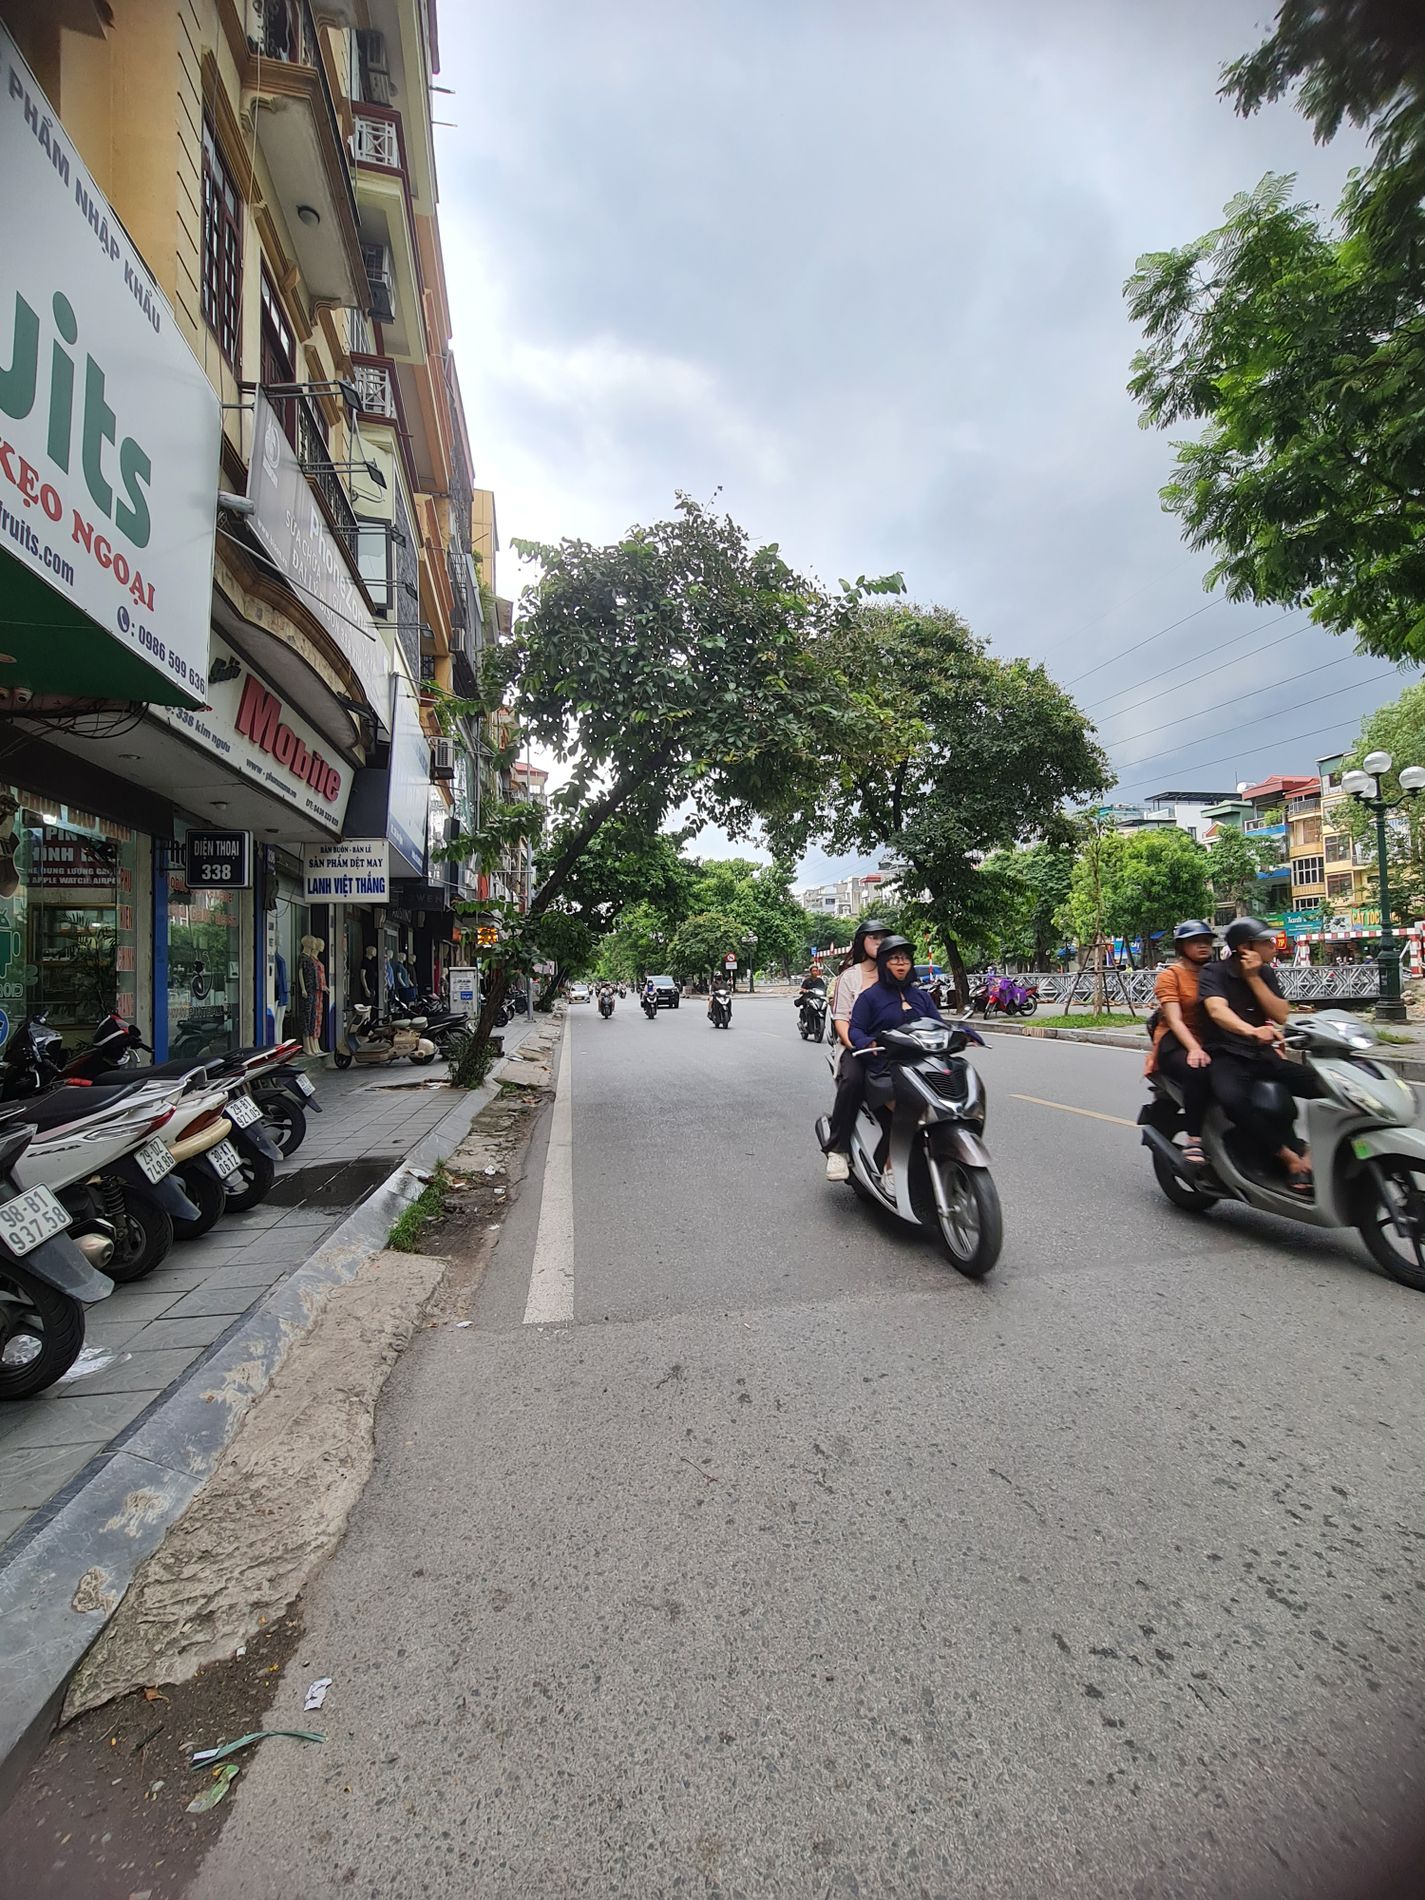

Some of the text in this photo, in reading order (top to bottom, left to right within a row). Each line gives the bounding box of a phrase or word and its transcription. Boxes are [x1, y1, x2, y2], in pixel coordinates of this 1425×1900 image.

[9, 64, 160, 334] PHẨM NHẬP KHẨU
[72, 509, 156, 612] NGOẠI
[138, 625, 166, 662] 0986
[168, 650, 187, 679] 599
[189, 669, 206, 695] 636
[176, 705, 194, 726] 338
[195, 719, 212, 741] kim
[234, 673, 342, 804] Mobile
[215, 839, 240, 860] THOẠI
[308, 854, 384, 869] SẢN PHẨM DỆT MAY
[201, 863, 231, 880] 338
[307, 871, 385, 897] LANH VIỆT THẮNG
[230, 1098, 252, 1117] 29-B1
[236, 1108, 261, 1129] 921.05
[138, 1142, 161, 1166] 29-D2
[219, 1152, 239, 1174] 0612
[146, 1154, 173, 1183] 748.86
[0, 1190, 49, 1229] 98-B1
[9, 1203, 67, 1252] 937.58
